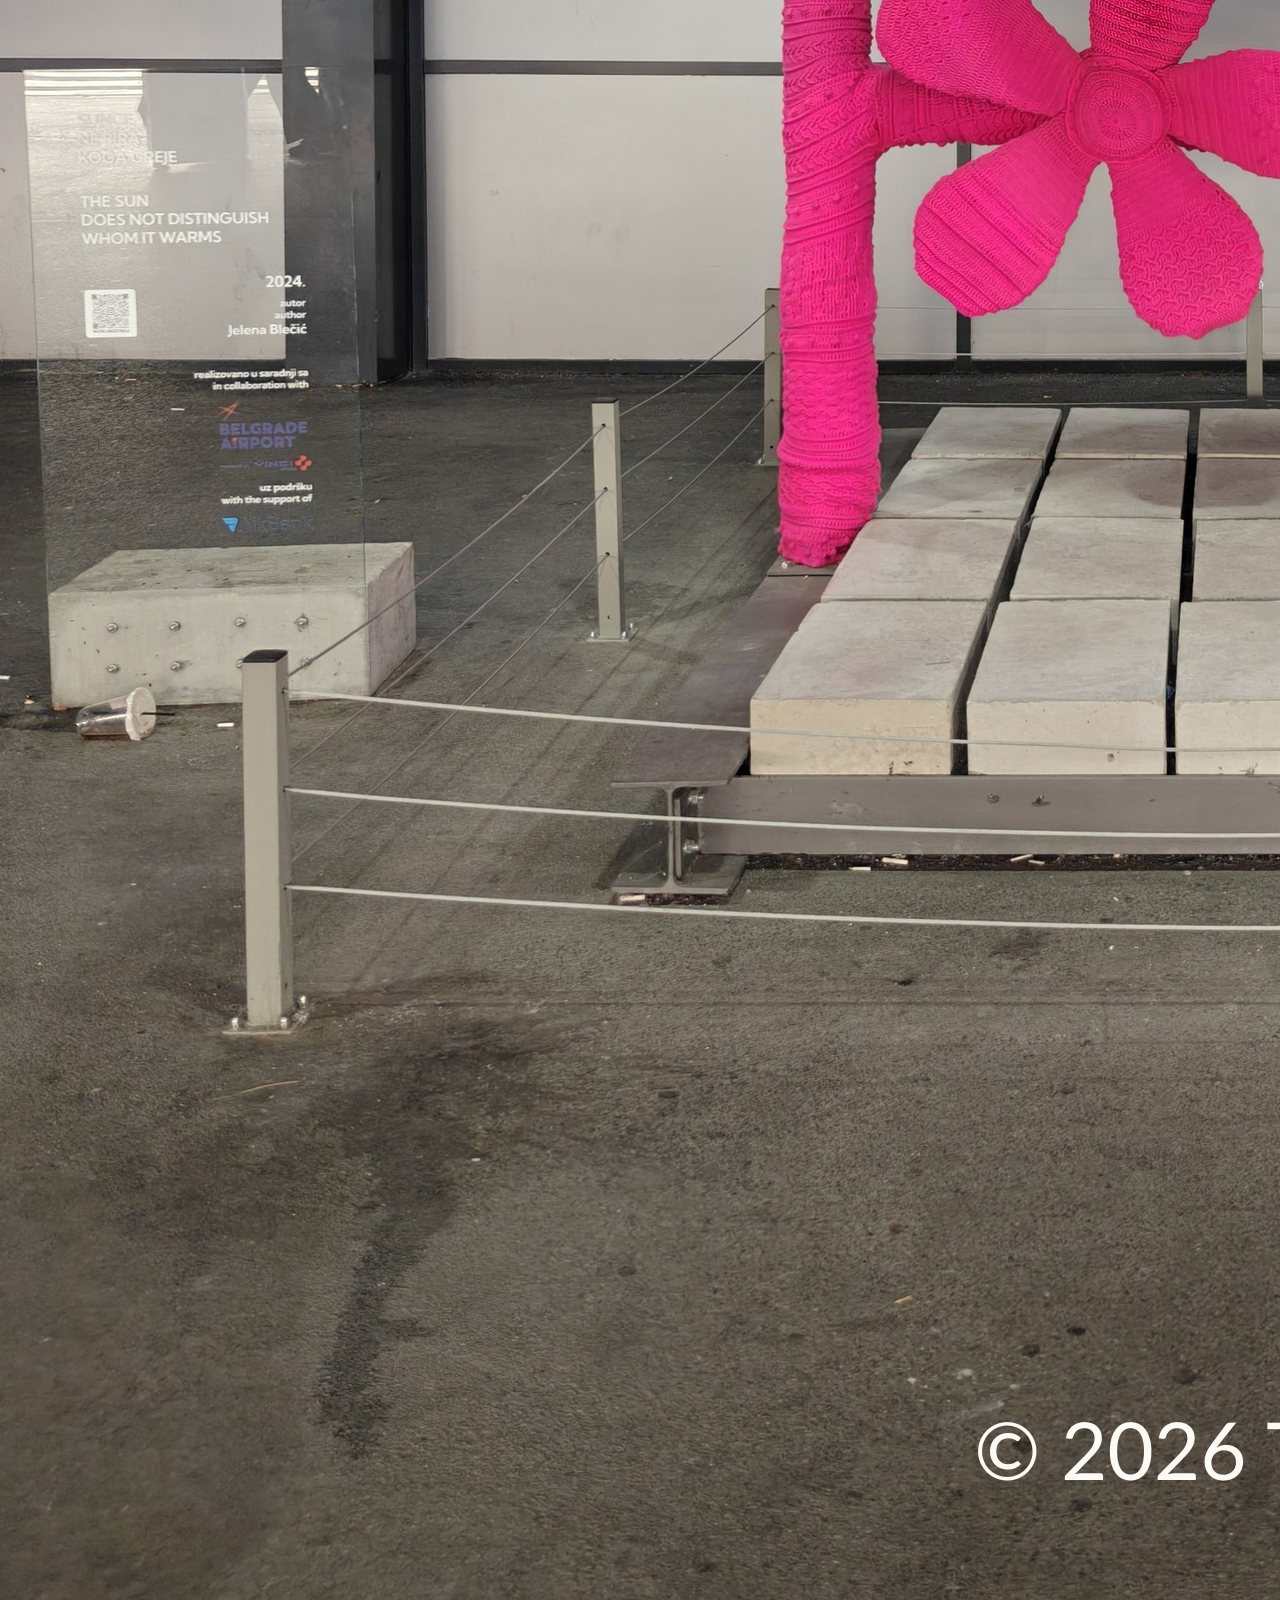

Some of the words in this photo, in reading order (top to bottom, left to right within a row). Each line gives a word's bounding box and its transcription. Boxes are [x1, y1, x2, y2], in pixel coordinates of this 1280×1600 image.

[79, 150, 127, 164] KOGA
[132, 150, 178, 165] GREJE
[80, 195, 111, 208] THE
[114, 195, 149, 207] SUN
[80, 213, 126, 226] DOES
[129, 212, 165, 226] NOT
[167, 211, 270, 225] DISTINGUISH
[81, 232, 138, 244] WHOM
[142, 231, 157, 244] IT
[158, 230, 222, 243] WARMS
[265, 275, 306, 288] 2024.
[274, 311, 307, 319] author
[226, 324, 267, 338] Jelena
[269, 323, 308, 335] Blečić
[193, 370, 250, 379] realizovano
[258, 368, 297, 379] saradnji
[297, 369, 309, 377] sa
[212, 382, 223, 390] in
[223, 380, 287, 390] collaboration
[287, 379, 310, 389] with
[218, 421, 309, 435] BELGRADE
[259, 484, 273, 492] uz
[273, 482, 313, 493] podršku
[220, 496, 244, 504] with
[244, 495, 262, 504] the
[262, 494, 301, 505] support
[301, 493, 313, 502] of
